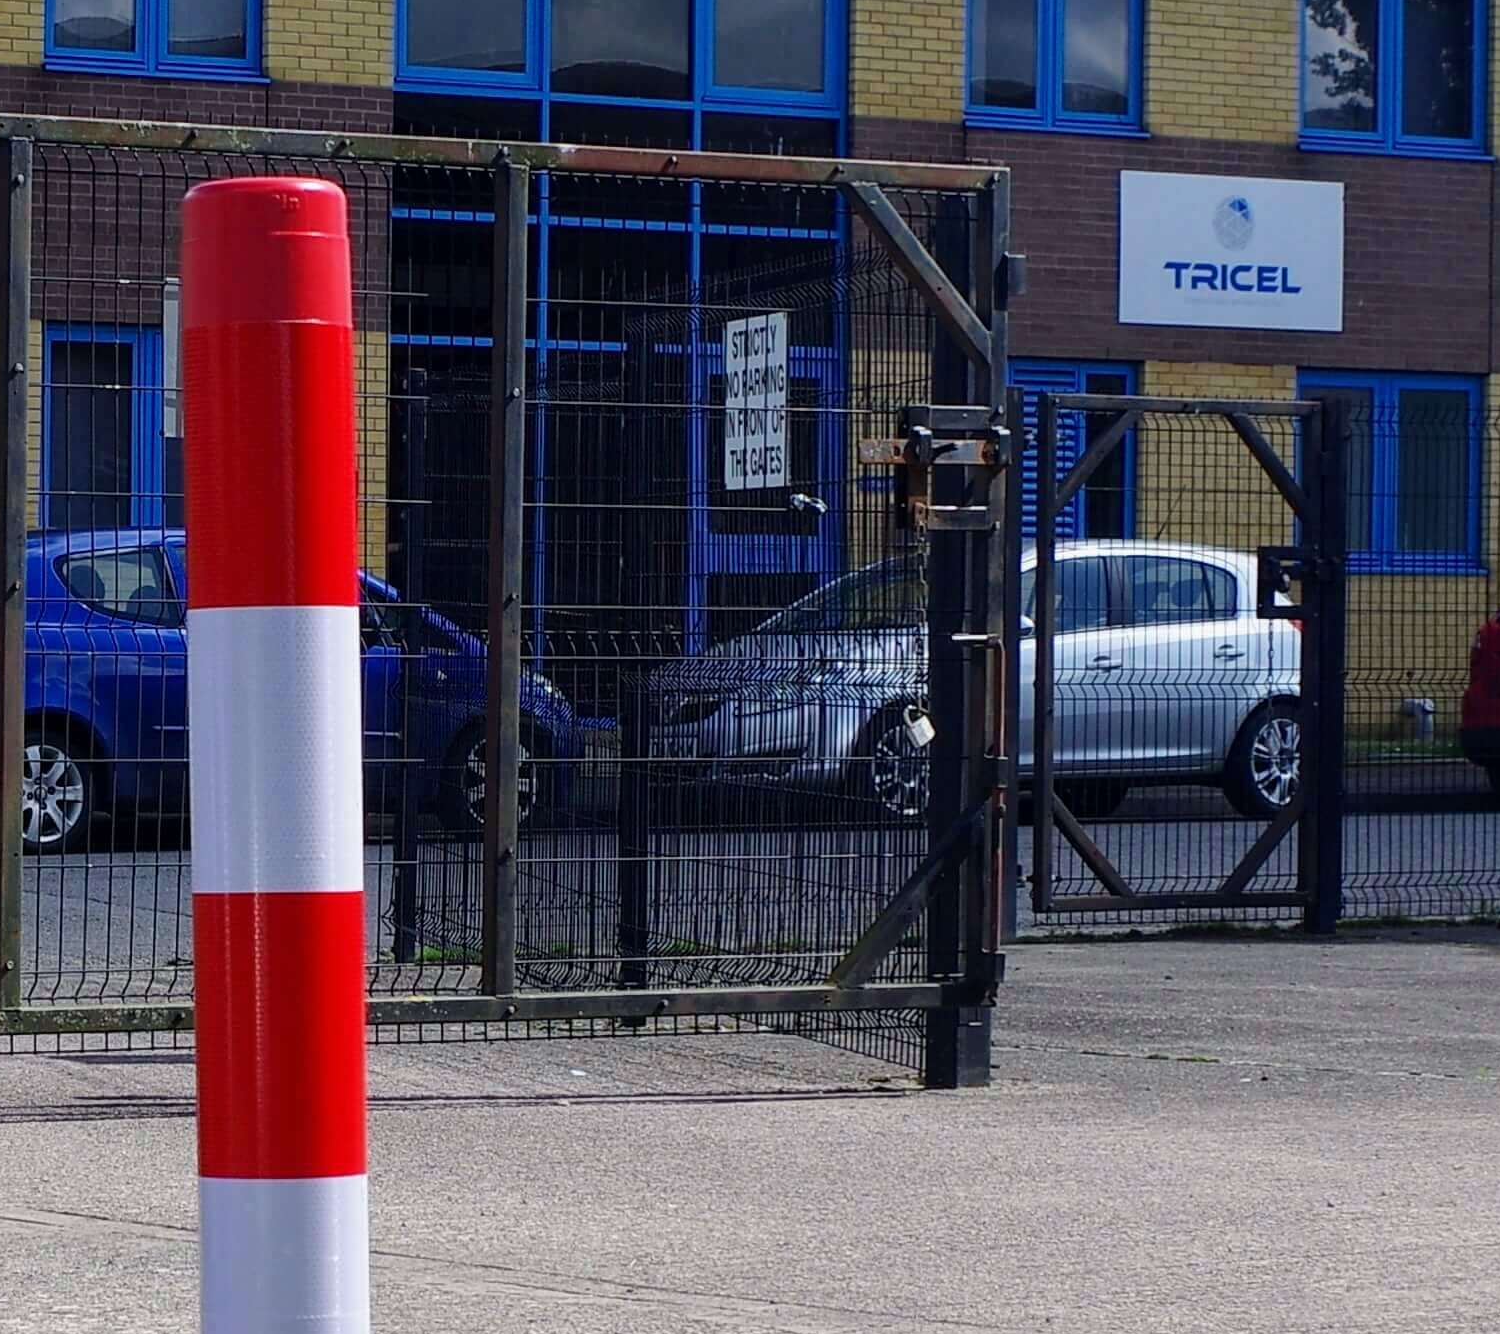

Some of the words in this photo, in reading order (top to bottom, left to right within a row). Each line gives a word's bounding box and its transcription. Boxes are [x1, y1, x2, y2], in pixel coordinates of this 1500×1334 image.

[1163, 261, 1302, 294] TRICEL
[727, 370, 740, 398] NO
[742, 363, 784, 397] PARKING
[726, 409, 736, 438] IN
[771, 404, 785, 434] OF
[750, 444, 783, 476] GATES
